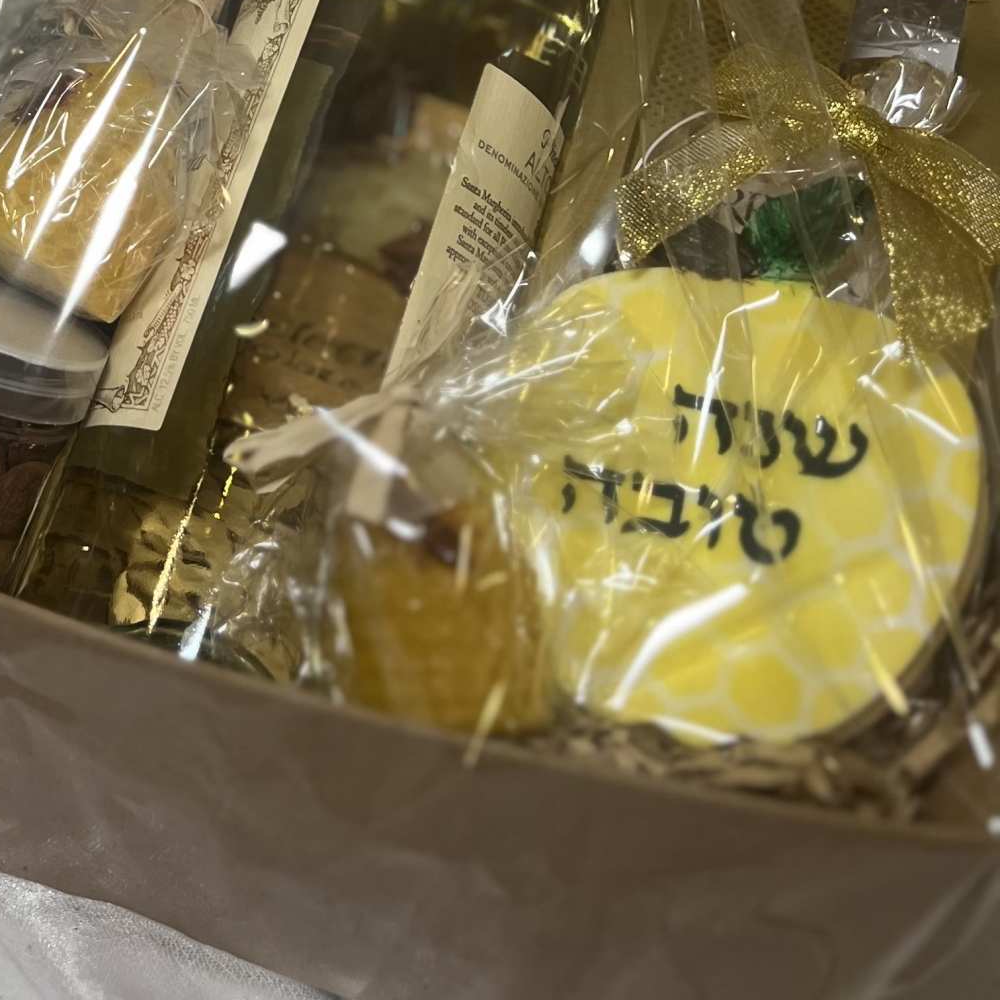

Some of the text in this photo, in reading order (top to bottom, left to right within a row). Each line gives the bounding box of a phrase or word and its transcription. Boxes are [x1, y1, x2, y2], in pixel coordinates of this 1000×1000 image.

[461, 176, 481, 198] Santa
[672, 383, 869, 479] שנה
[561, 454, 802, 565] טובה
